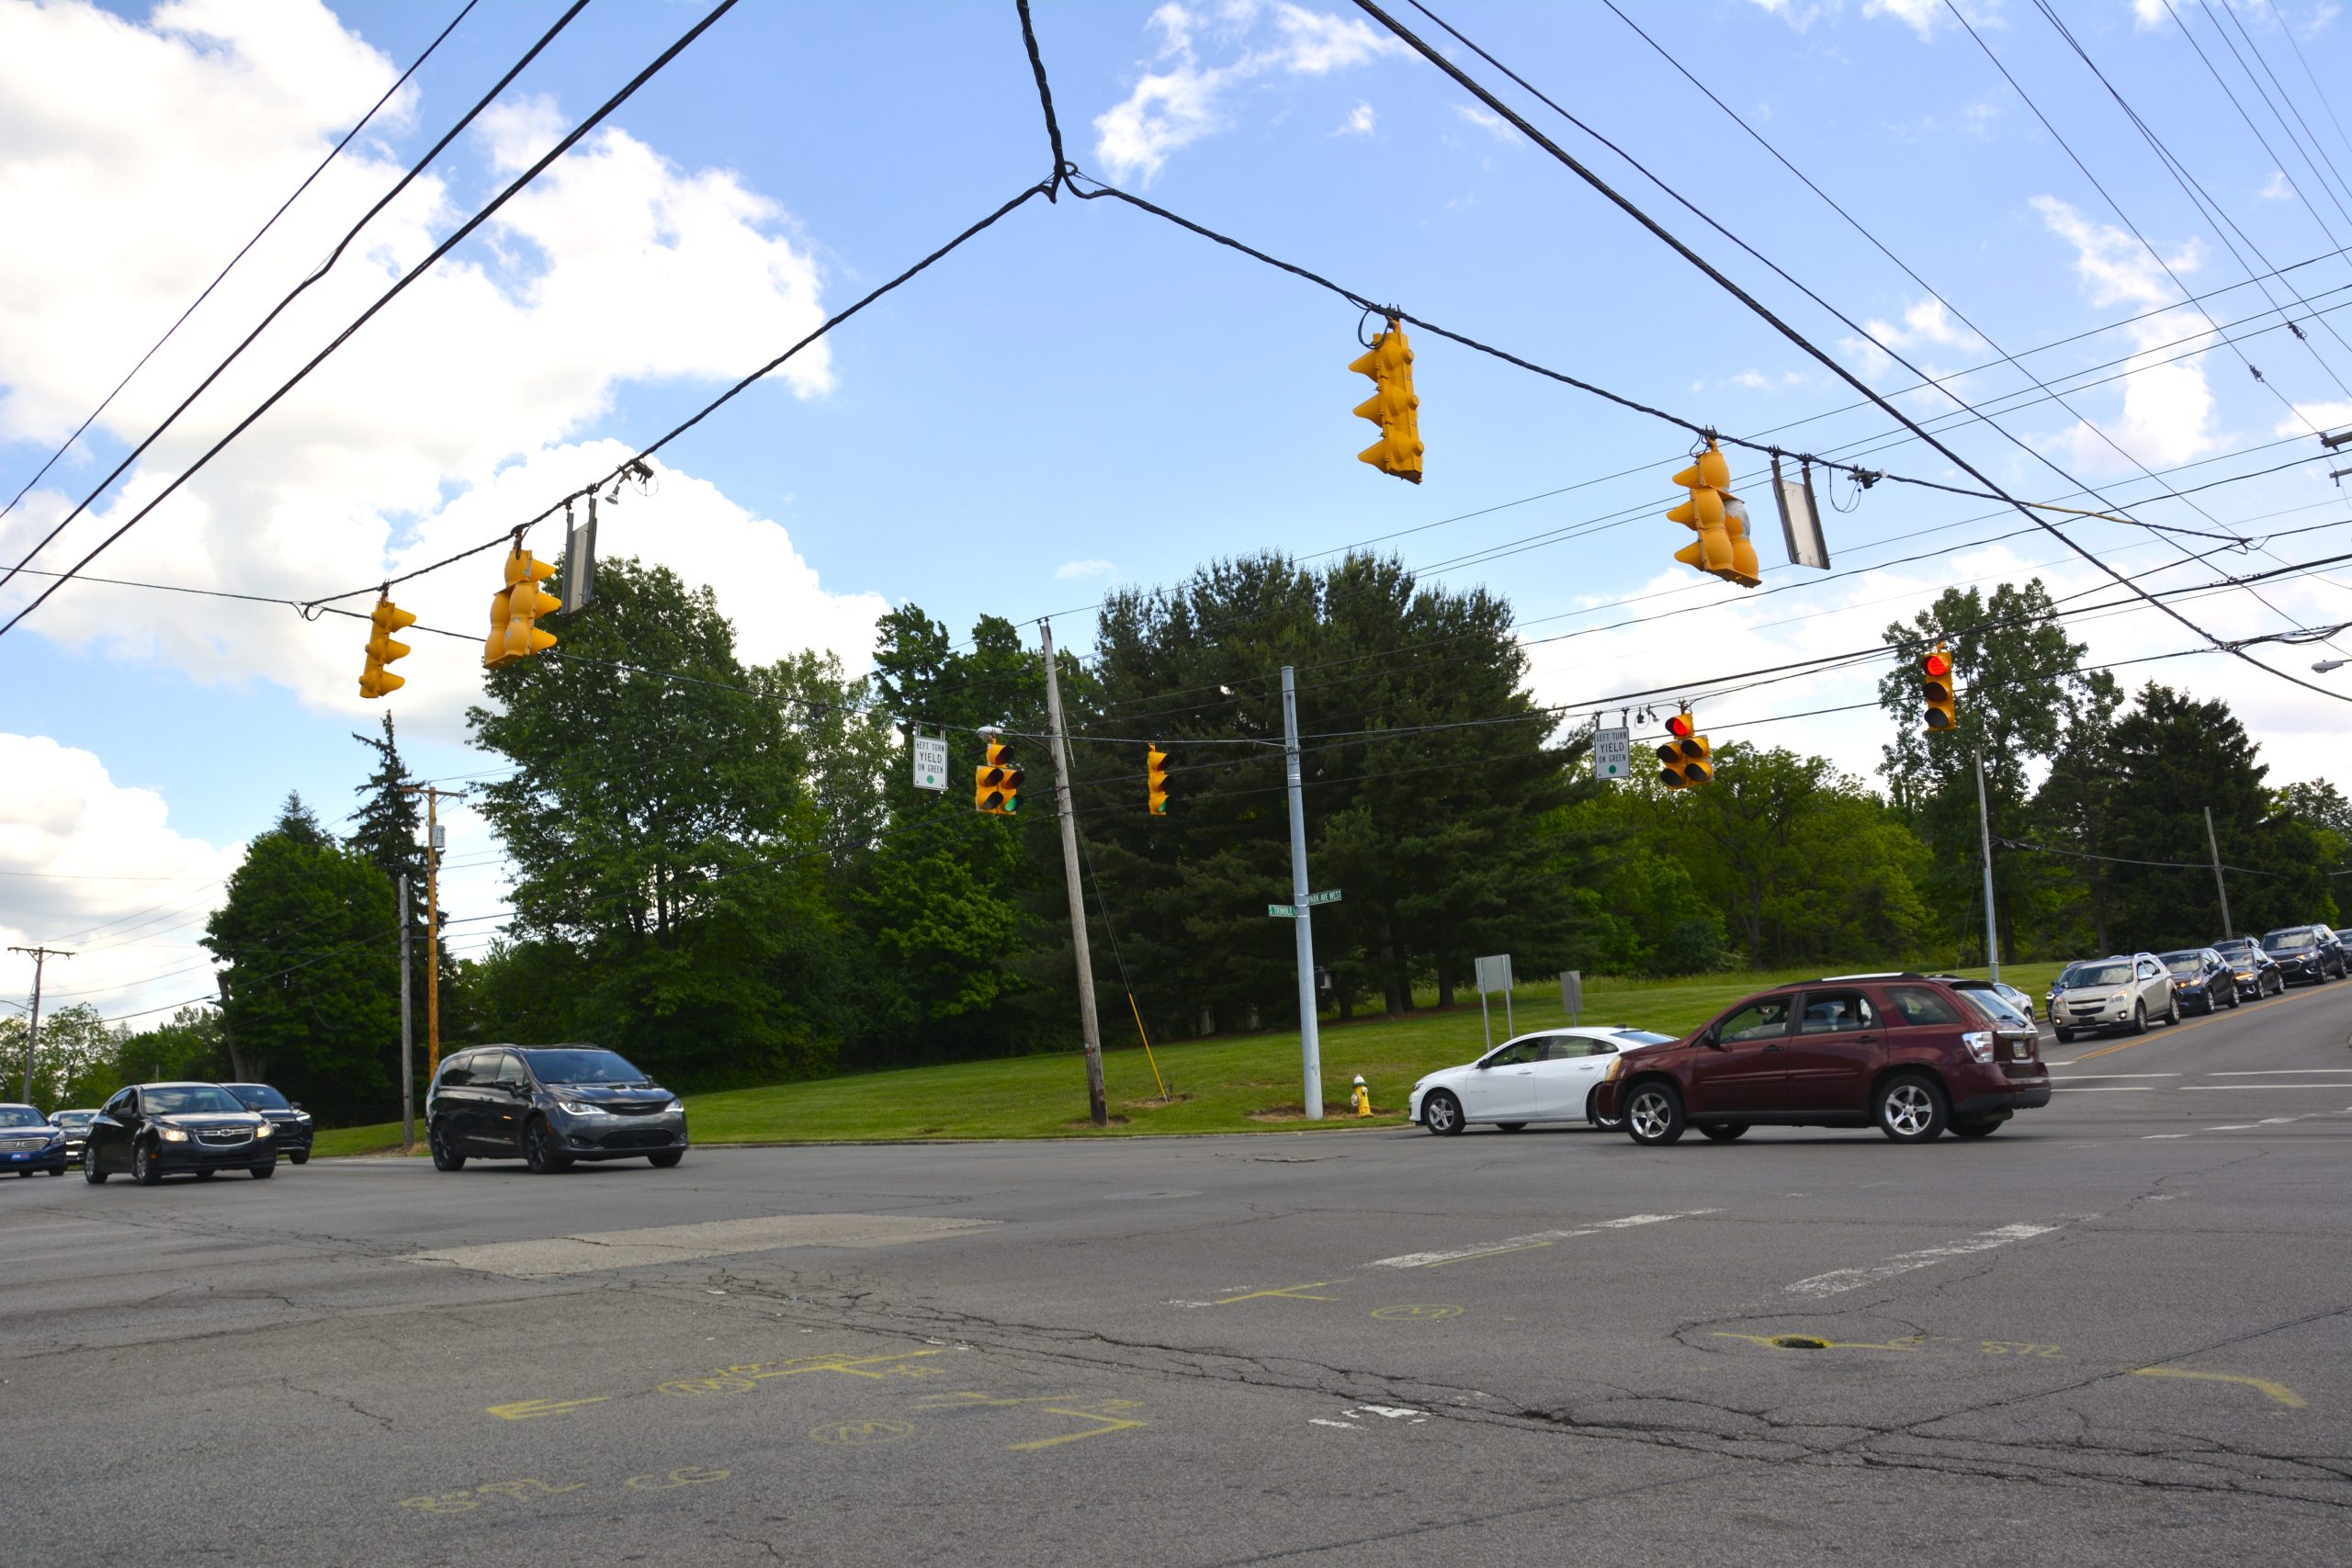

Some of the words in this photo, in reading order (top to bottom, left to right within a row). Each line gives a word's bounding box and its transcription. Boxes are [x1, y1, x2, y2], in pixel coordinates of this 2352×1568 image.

[916, 741, 929, 750] LEFT
[932, 743, 944, 752] TURN
[1600, 742, 1624, 752] YIELD
[920, 752, 942, 763] YIELD
[1599, 755, 1606, 763] ON
[1609, 754, 1626, 762] GREEN
[918, 763, 925, 772] ON
[928, 764, 944, 774] GREEN
[1308, 895, 1320, 904] PARK
[1320, 893, 1329, 902] AVE
[1329, 890, 1341, 900] WEST
[1274, 907, 1294, 916] TRIMBLE
